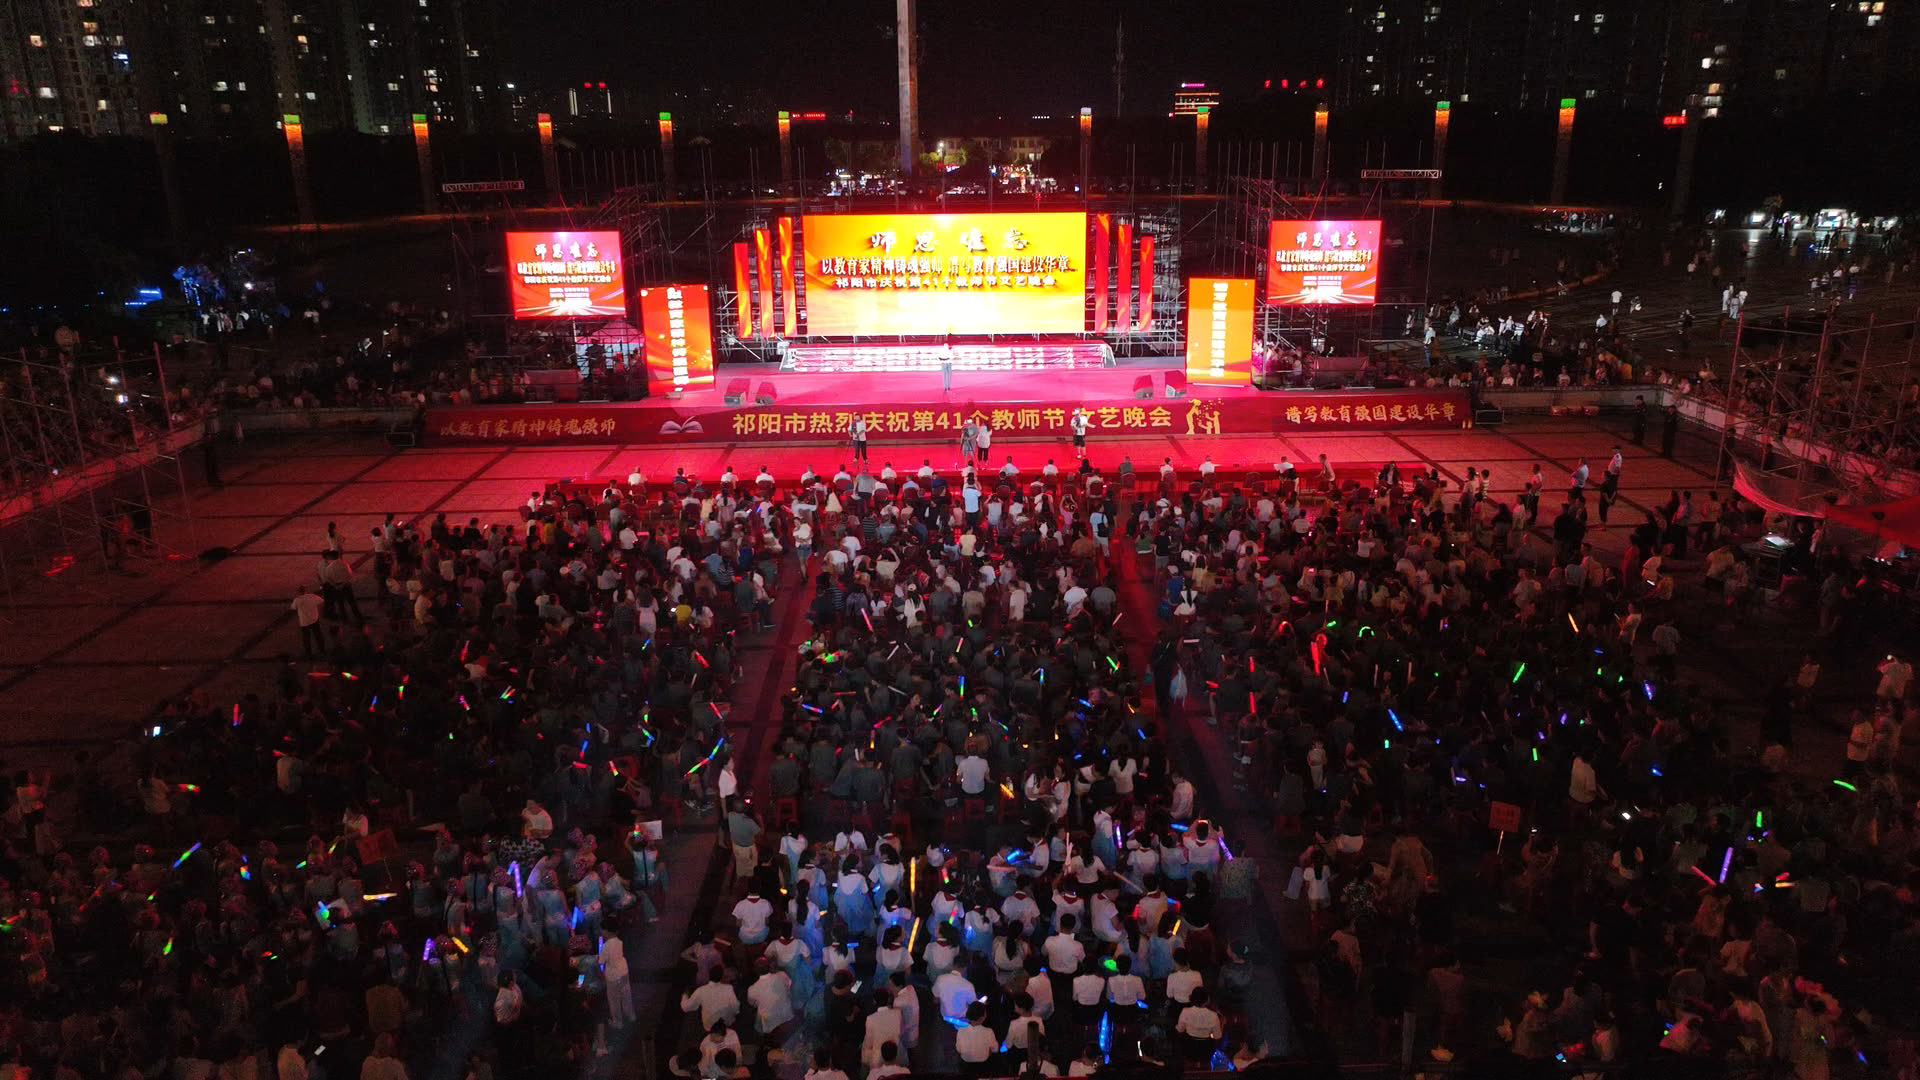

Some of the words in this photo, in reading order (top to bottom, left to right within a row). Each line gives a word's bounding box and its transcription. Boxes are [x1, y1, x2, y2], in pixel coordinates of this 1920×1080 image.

[1285, 402, 1456, 424] 谱写教育强国建设华章
[440, 417, 616, 437] 以教育家精神铸魂强师
